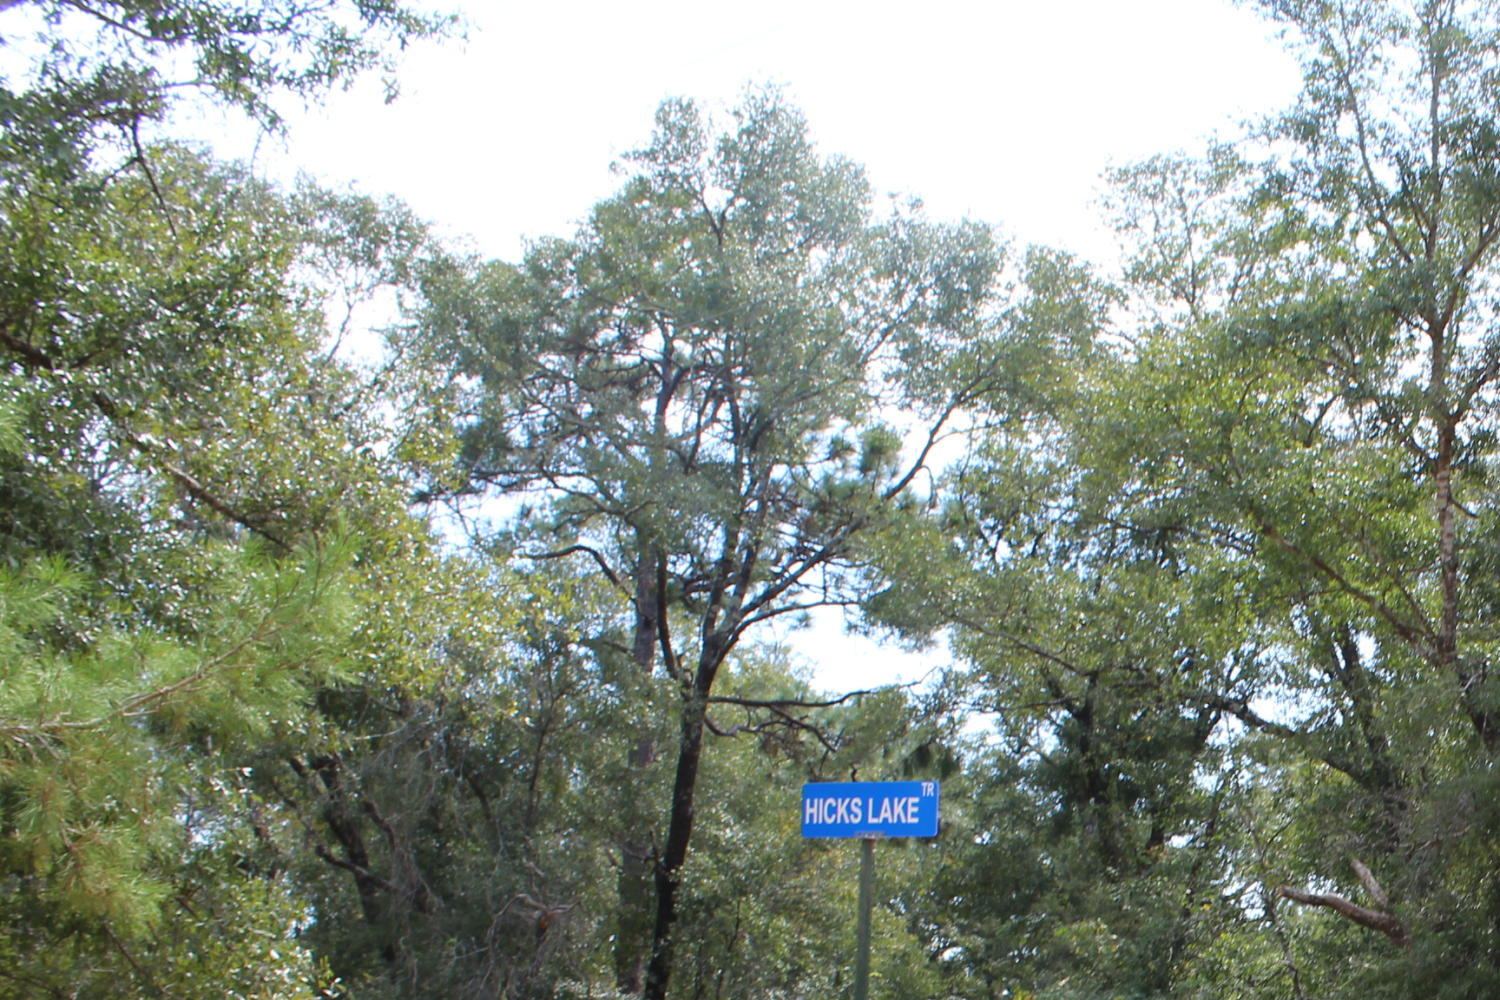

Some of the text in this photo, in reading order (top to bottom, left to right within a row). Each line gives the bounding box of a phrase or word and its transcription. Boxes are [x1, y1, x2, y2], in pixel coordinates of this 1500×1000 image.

[921, 782, 935, 798] TR
[804, 796, 921, 825] HICKS LAKE
